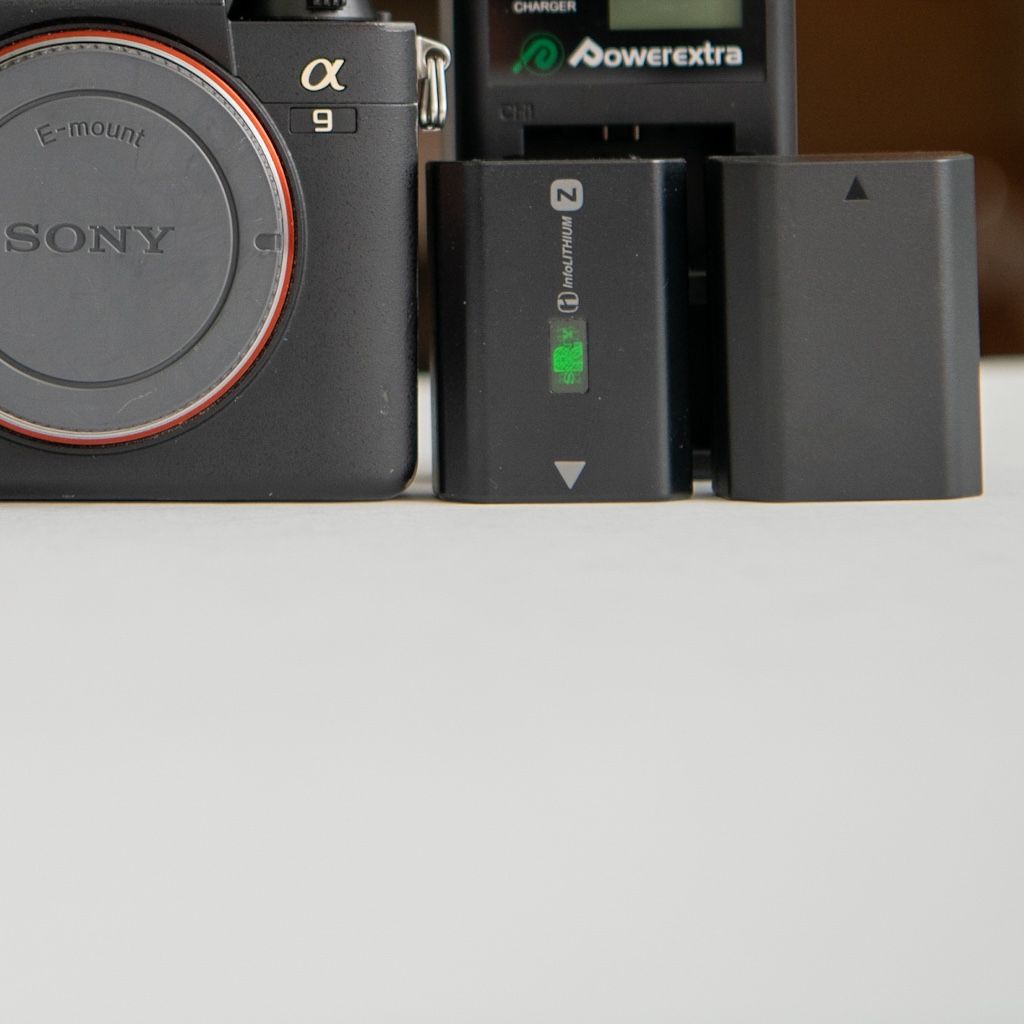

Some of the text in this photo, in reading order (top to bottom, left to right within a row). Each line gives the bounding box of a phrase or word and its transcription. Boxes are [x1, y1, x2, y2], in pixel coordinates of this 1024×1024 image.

[512, 0, 576, 14] CHARGER
[36, 116, 149, 149] E-mount
[311, 109, 334, 132] 9
[3, 222, 175, 255] SONY
[562, 215, 574, 289] InfoLITHIUM
